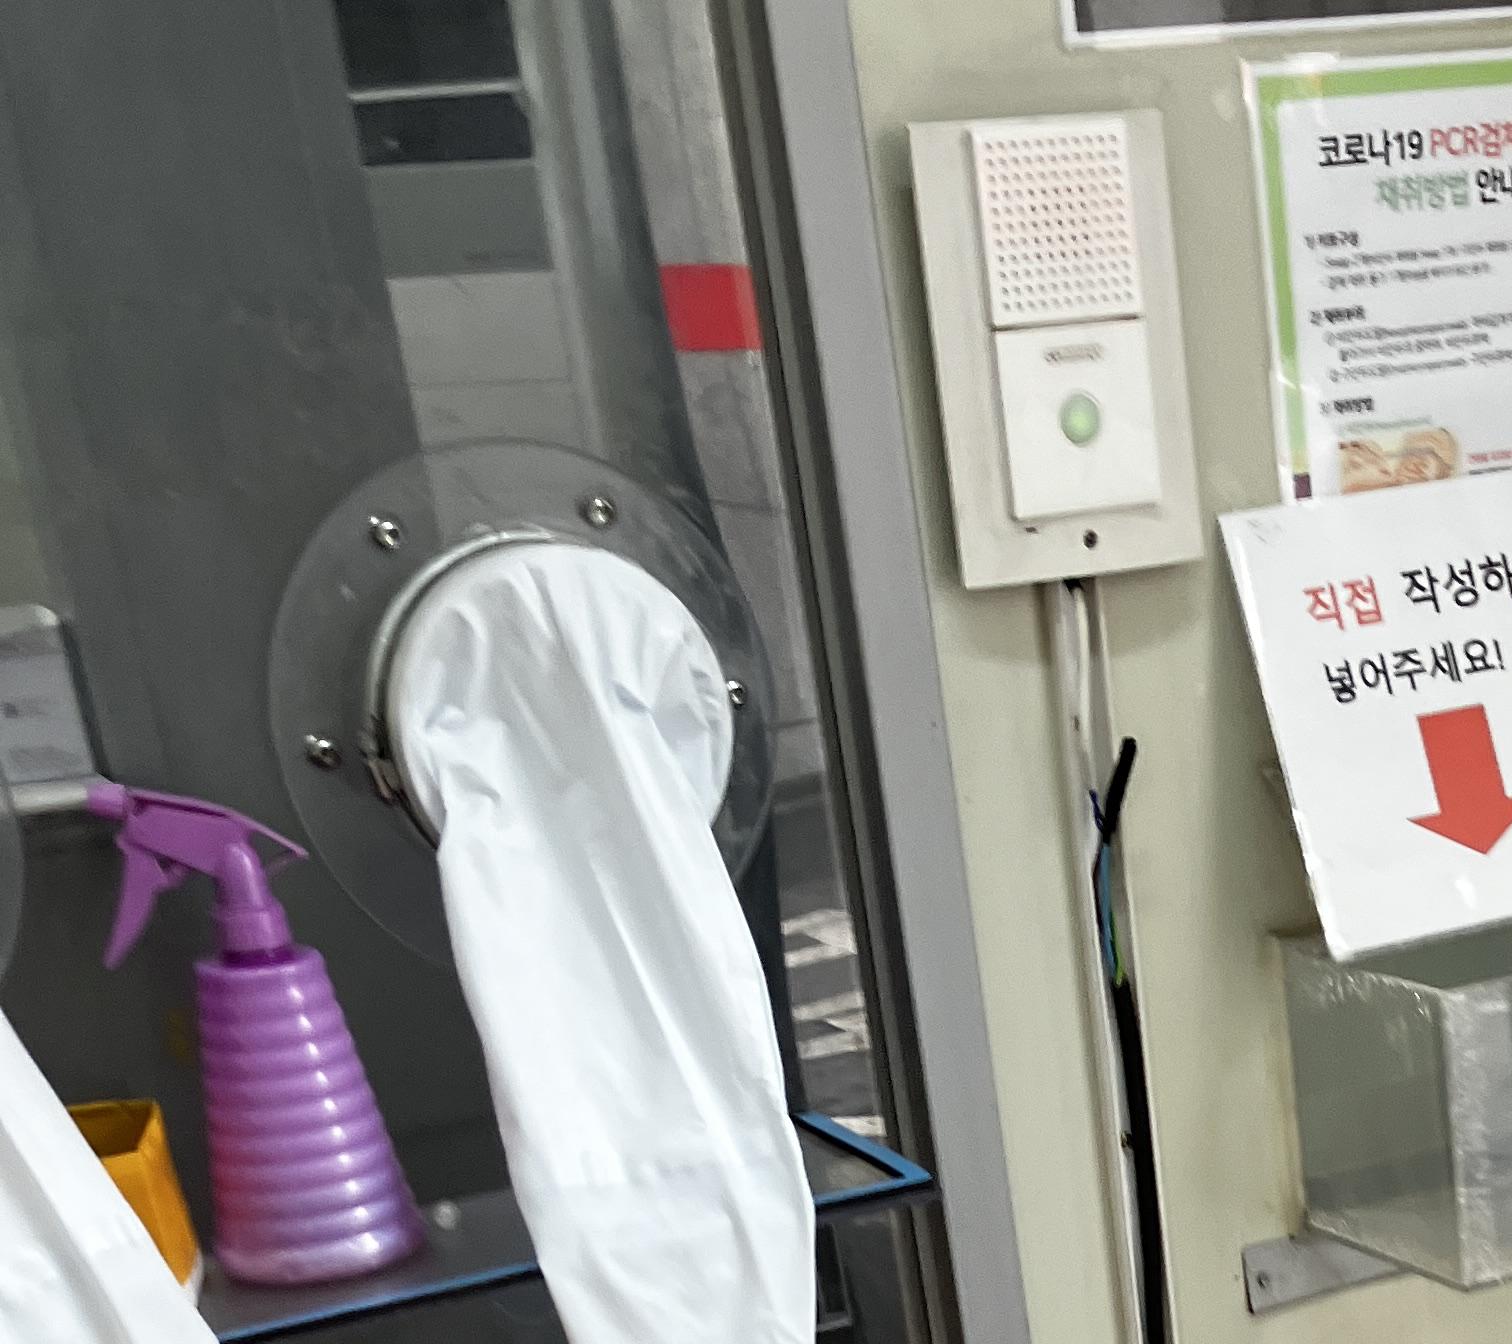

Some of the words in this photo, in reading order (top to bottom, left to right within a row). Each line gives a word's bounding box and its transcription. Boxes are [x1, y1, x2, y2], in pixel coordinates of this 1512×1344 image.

[1318, 128, 1423, 167] 코로나19
[1302, 575, 1385, 632] 직접
[1323, 639, 1506, 704] 넣어주세요!
